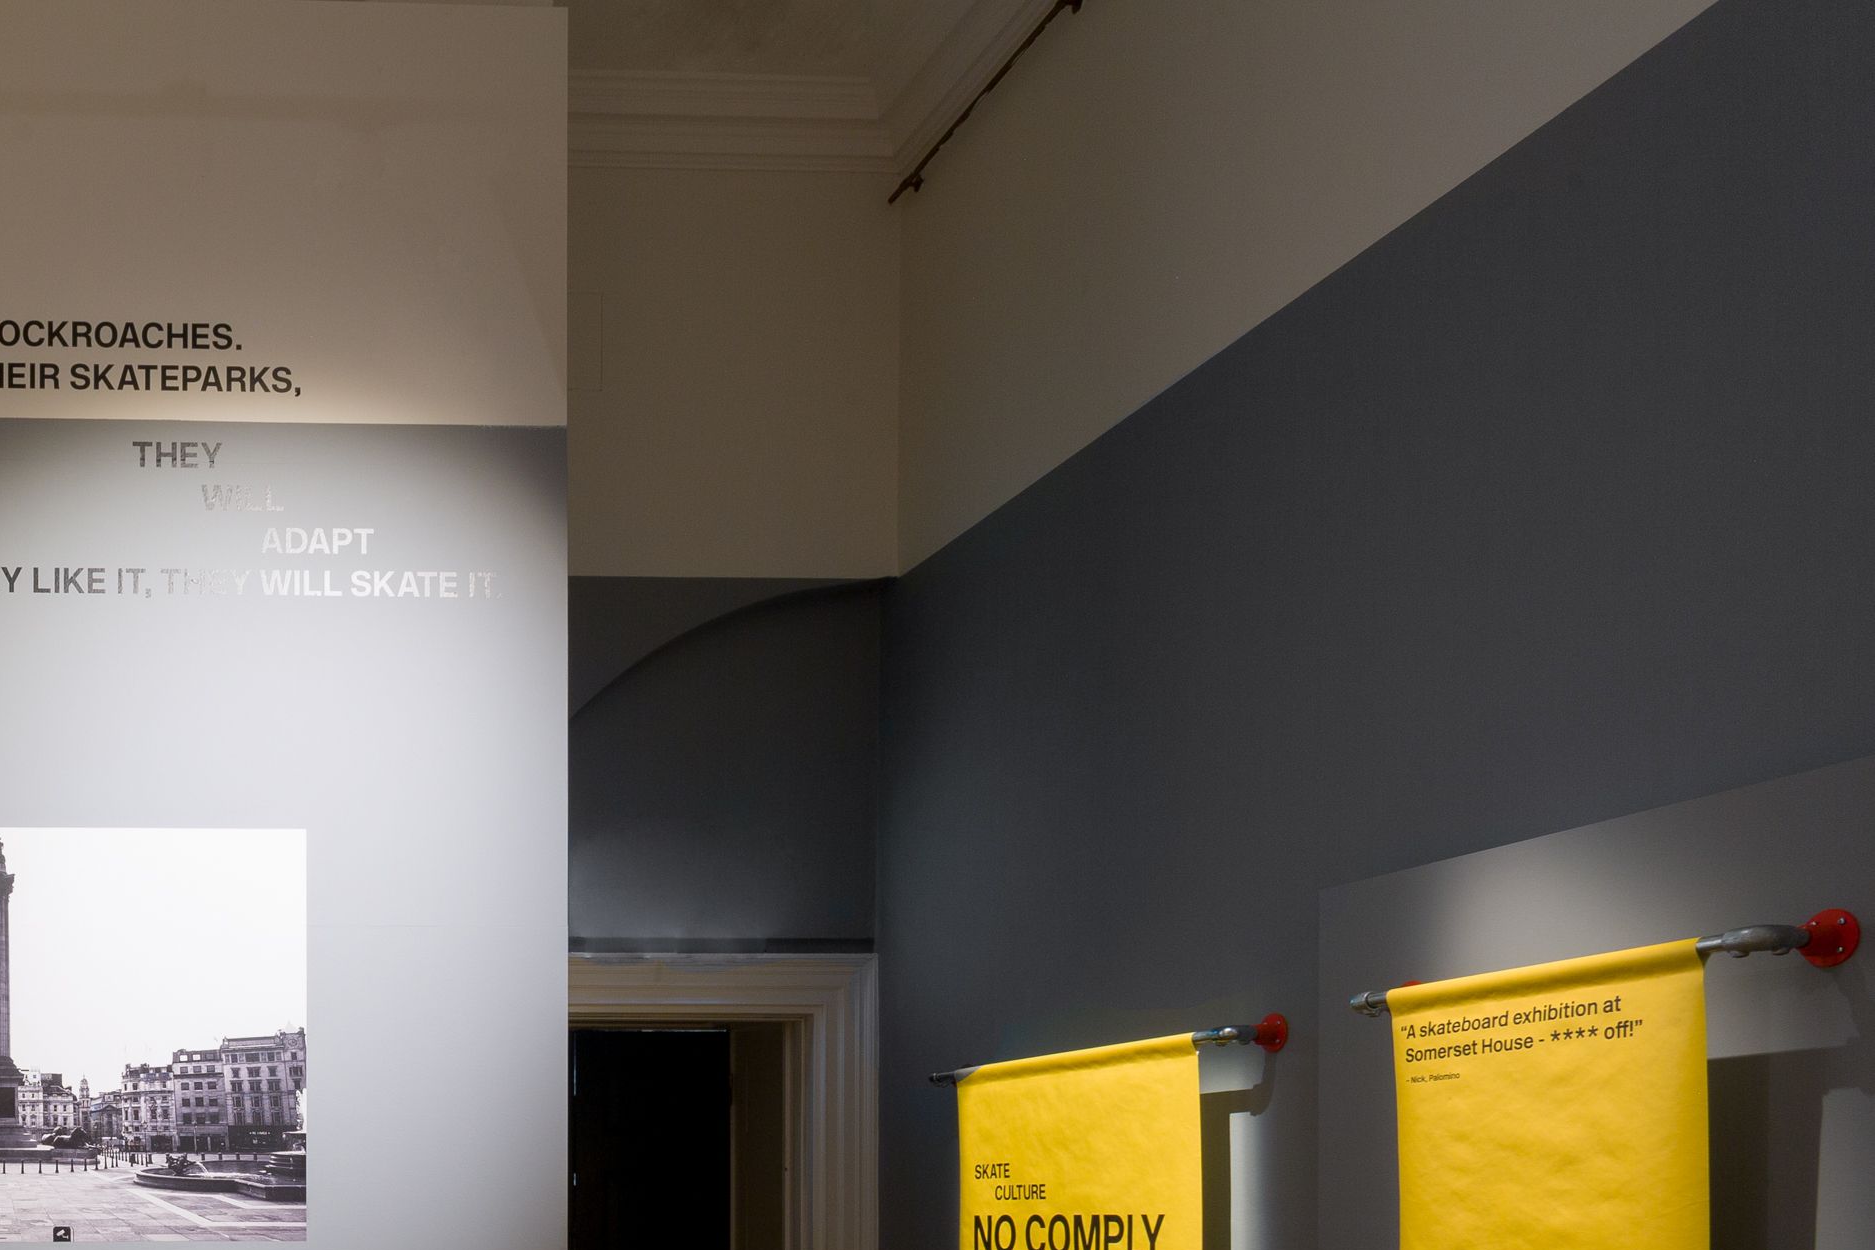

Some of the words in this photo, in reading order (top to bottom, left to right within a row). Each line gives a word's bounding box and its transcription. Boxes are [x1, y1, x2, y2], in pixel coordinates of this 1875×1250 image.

[69, 363, 301, 397] SKATEPARKS,
[132, 441, 222, 469] THEY
[201, 484, 284, 512] WILL
[261, 528, 374, 555] ADAPT
[32, 567, 105, 594] LIKE
[117, 567, 151, 599] IT,
[160, 568, 251, 596] THEY
[259, 569, 343, 597] WILL
[350, 570, 458, 599] SKATE
[1419, 1010, 1509, 1038] skateboard
[1513, 1002, 1598, 1025] exhibition
[1602, 996, 1622, 1013] at
[1405, 1040, 1478, 1063] Somerset
[1481, 1035, 1534, 1054] House
[1428, 1072, 1461, 1082] Palomino
[974, 1162, 1011, 1180] SKATE
[994, 1184, 1047, 1201] CULTURE
